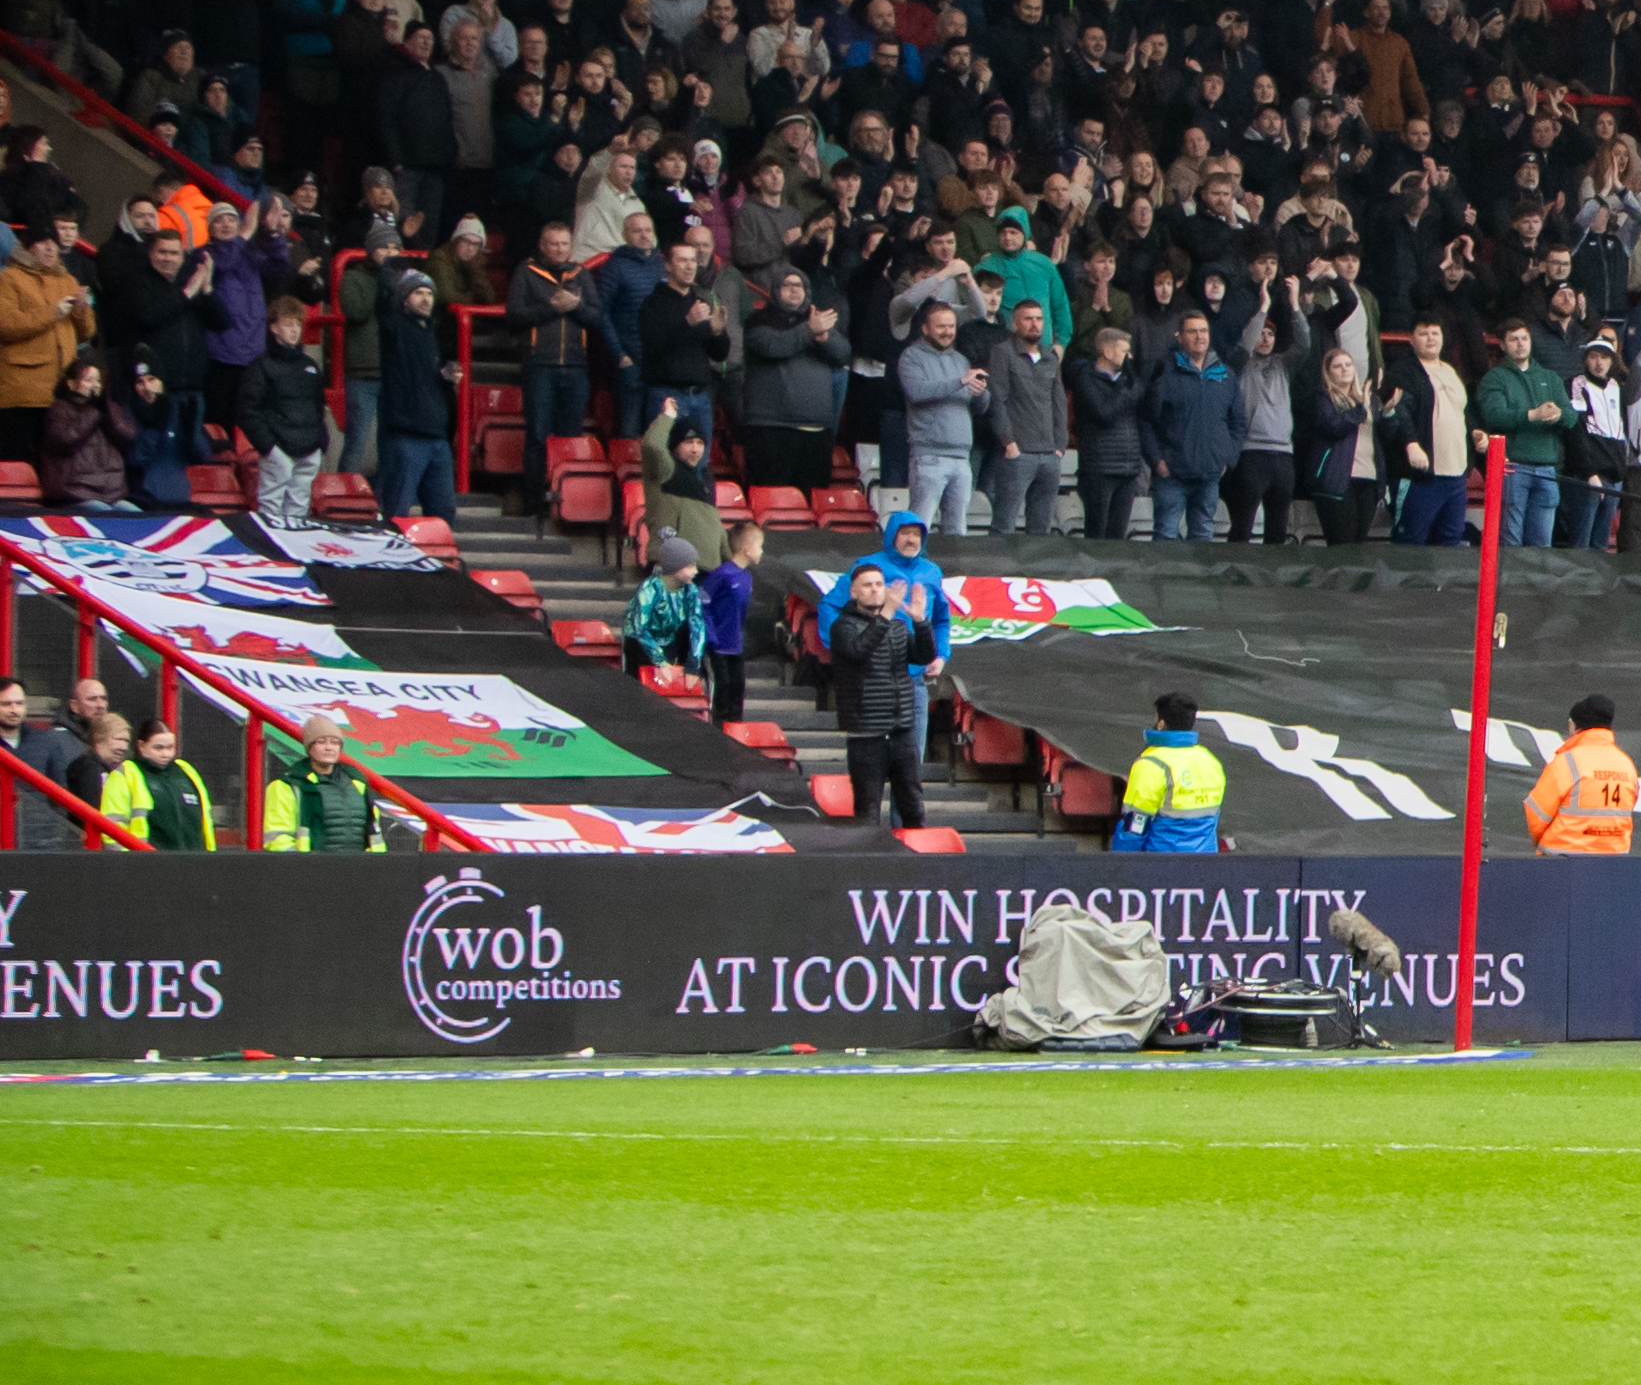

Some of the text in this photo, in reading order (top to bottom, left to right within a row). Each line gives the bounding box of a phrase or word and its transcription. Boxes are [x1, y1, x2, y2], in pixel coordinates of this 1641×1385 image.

[202, 662, 484, 702] SWANSEA CITY
[1593, 769, 1629, 782] RESPONSE
[1602, 782, 1620, 807] 14
[432, 904, 564, 970] wob
[847, 889, 978, 946] WIN
[435, 970, 622, 1009] competitions
[675, 957, 756, 1015] AT
[770, 955, 988, 1013] ICONIC
